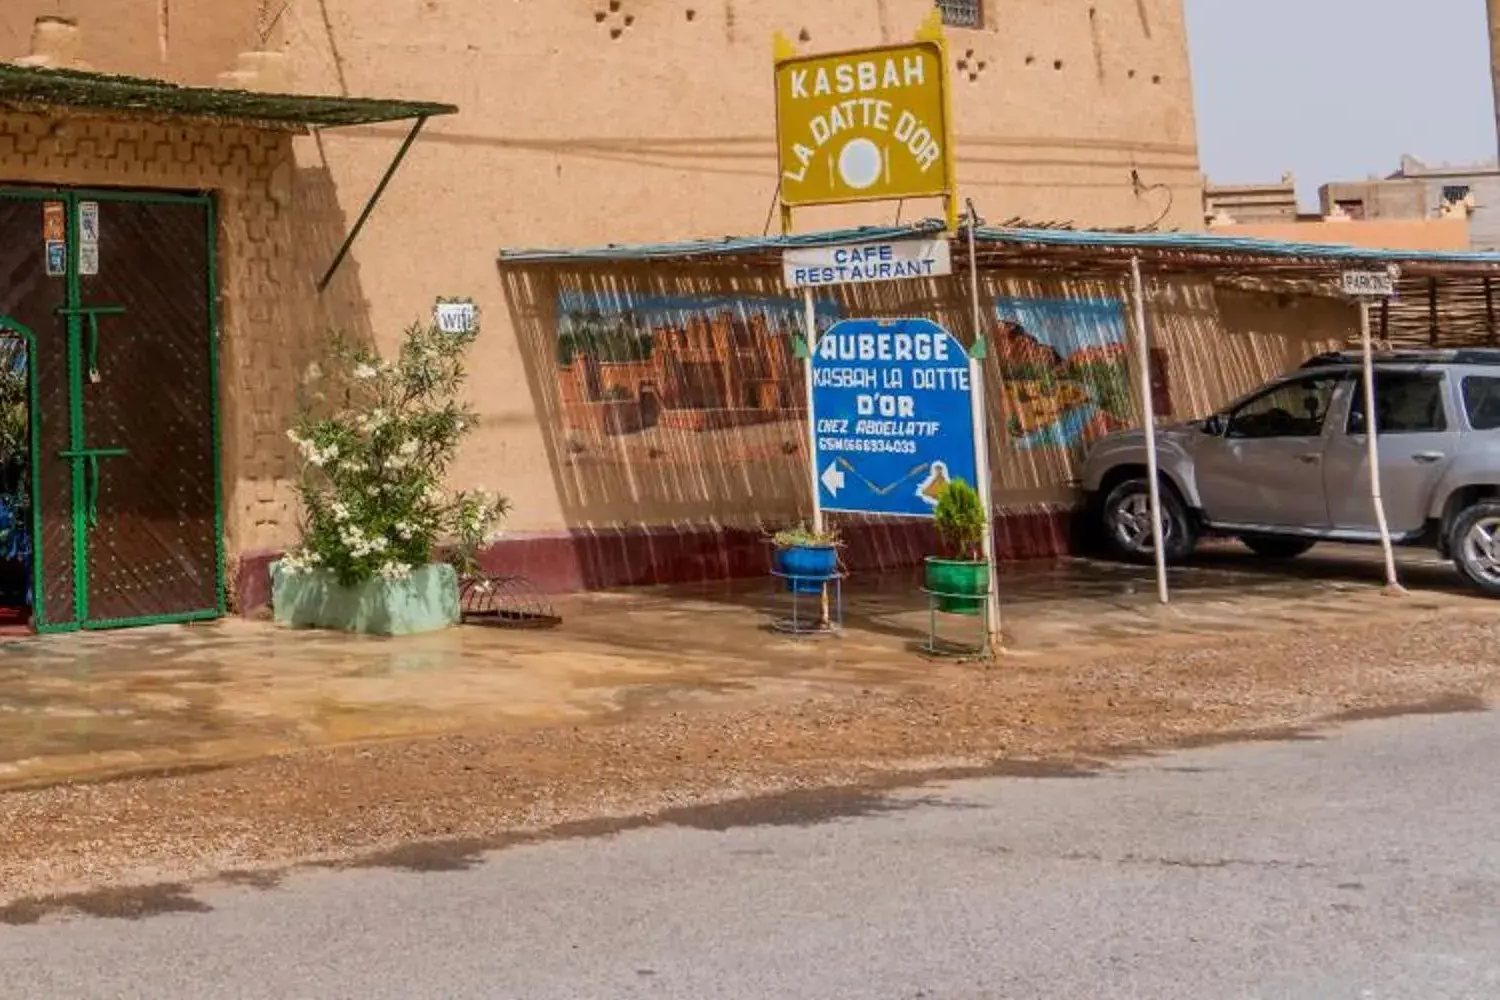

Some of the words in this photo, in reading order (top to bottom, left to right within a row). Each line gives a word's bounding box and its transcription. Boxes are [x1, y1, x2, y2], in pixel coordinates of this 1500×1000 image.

[791, 55, 925, 99] KASBAH
[783, 143, 815, 182] LA
[809, 97, 893, 146] DATTE
[834, 245, 893, 263] CAFE
[795, 259, 936, 285] RESTAURANT
[820, 333, 950, 361] AUBERGE
[813, 366, 878, 388] KASBAH
[883, 367, 903, 389] LA
[912, 367, 971, 391] DATTE
[856, 393, 915, 417] D'OR
[817, 418, 849, 434] CHEZ
